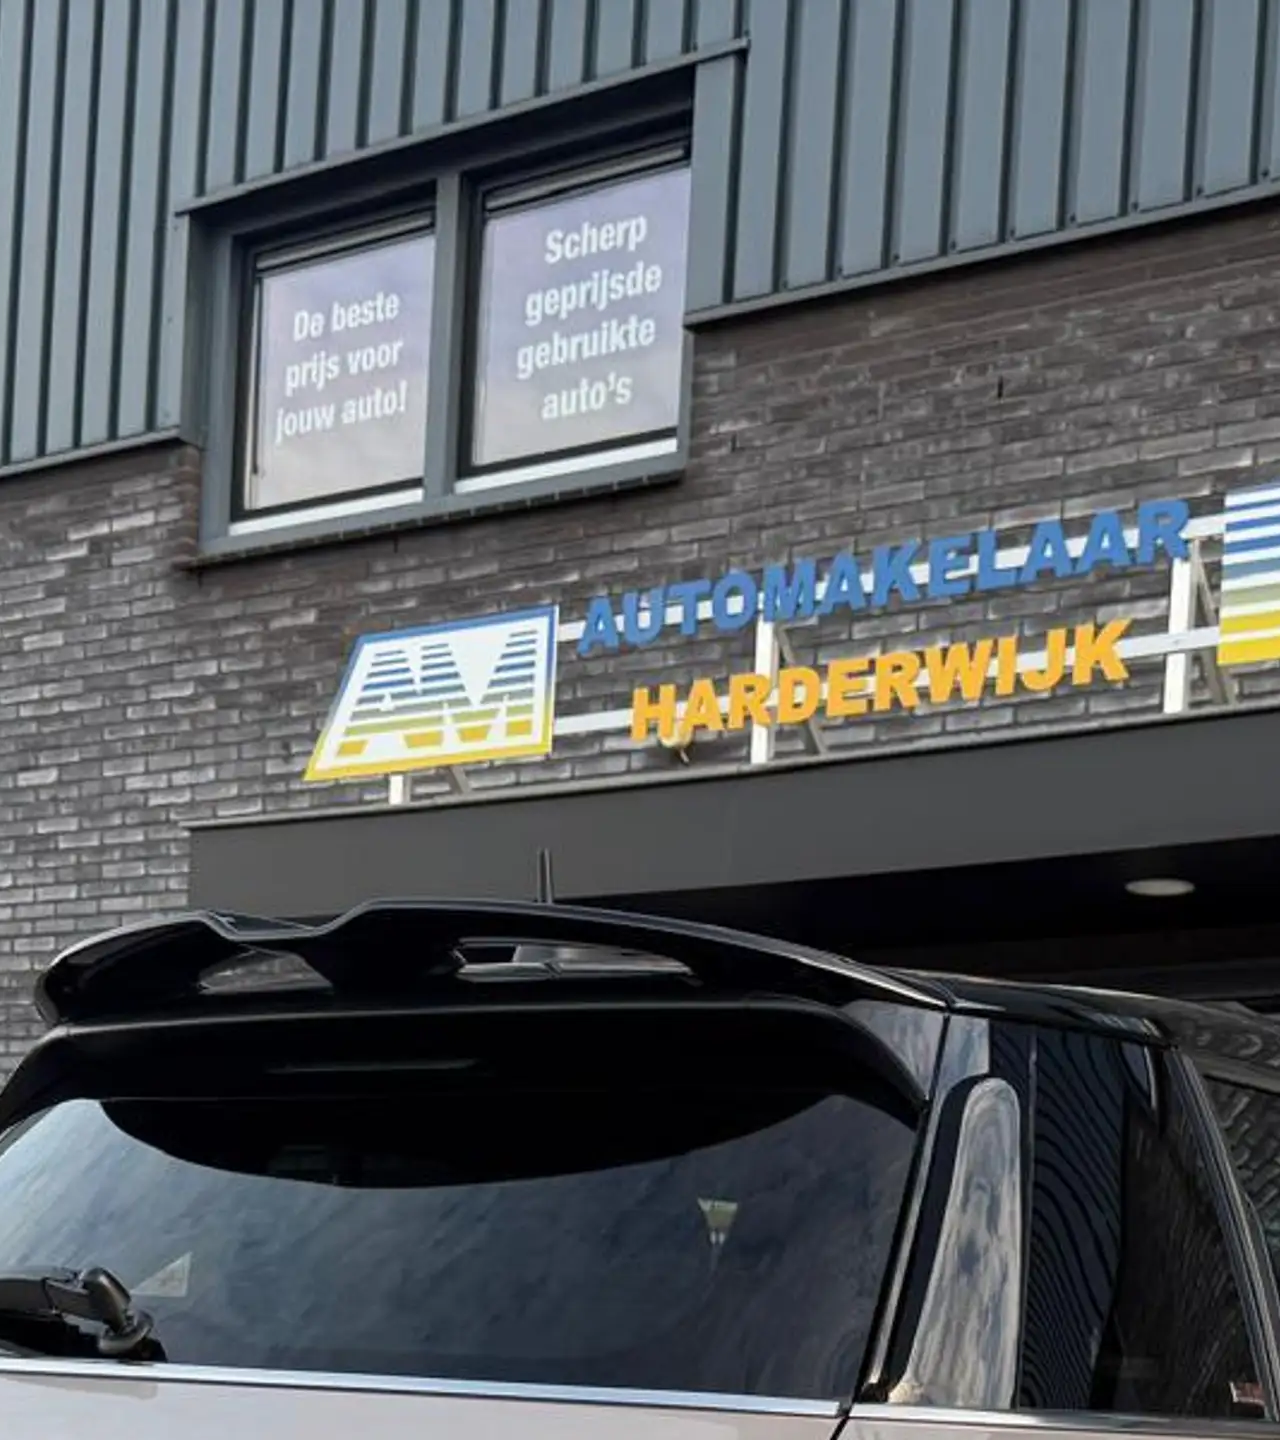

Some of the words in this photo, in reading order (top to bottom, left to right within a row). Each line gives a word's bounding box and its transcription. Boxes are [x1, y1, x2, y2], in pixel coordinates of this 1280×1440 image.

[544, 215, 648, 264] Scherp
[293, 310, 325, 342] De
[331, 291, 400, 333] beste
[525, 260, 662, 327] geprijsde
[285, 350, 341, 398] prijs
[347, 338, 404, 375] voor
[516, 313, 656, 380] gebruikte
[275, 402, 335, 445] jouw
[341, 379, 408, 424] auto!
[541, 371, 633, 420] auto's
[576, 500, 1191, 656] AUTOMAKELAAR
[630, 618, 1135, 742] HARDERWIJK
